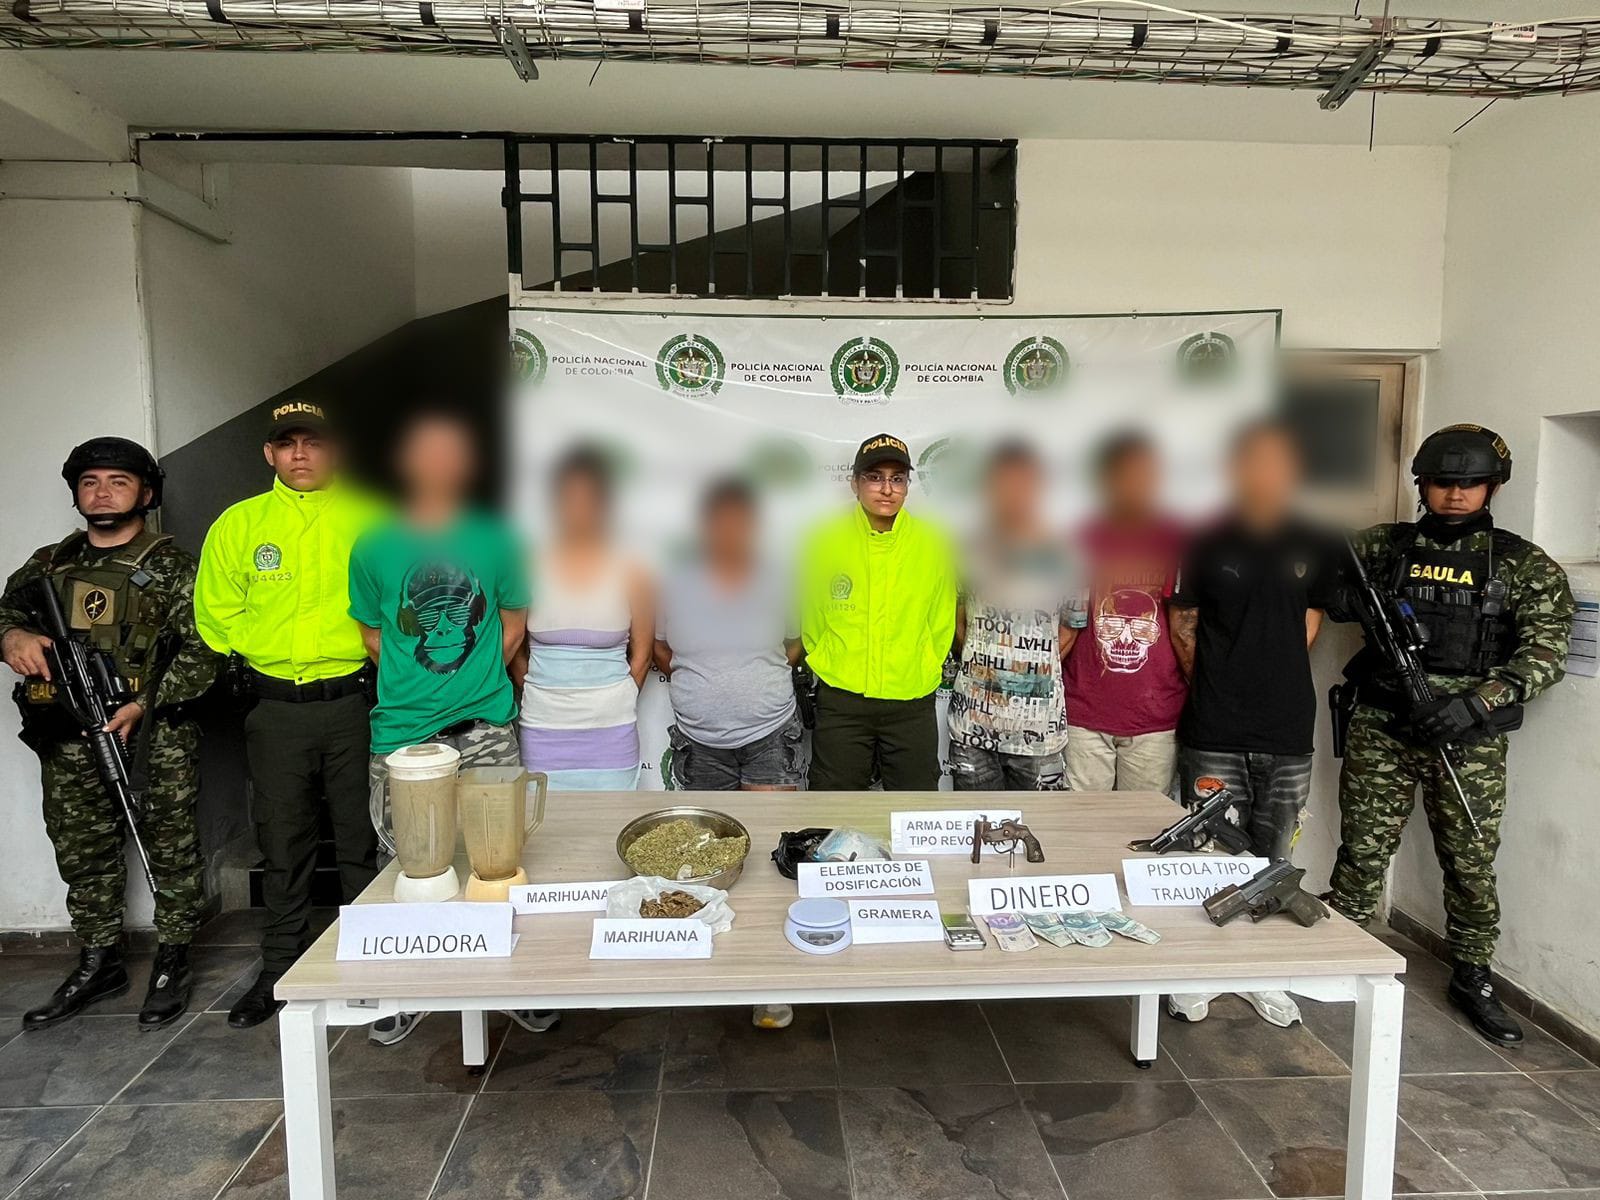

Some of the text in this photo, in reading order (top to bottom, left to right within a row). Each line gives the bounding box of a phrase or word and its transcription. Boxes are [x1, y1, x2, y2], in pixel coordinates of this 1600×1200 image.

[552, 354, 648, 368] POLICÍA NACIONAL
[731, 362, 825, 372] POLICÍA NACIONAL
[905, 362, 998, 372] POLICÍA NACIONAL
[565, 367, 578, 376] DE
[744, 374, 812, 383] DE COLOMBIA
[917, 374, 984, 383] DE COLOMBIA
[1410, 564, 1474, 586] GAULA
[906, 820, 942, 831] ARMA
[945, 820, 962, 831] DE
[909, 835, 937, 846] TIPO
[819, 862, 923, 877] ELEMENTOS DE
[1146, 862, 1250, 877] PISTOLA TIPO
[825, 876, 922, 891] DOSIFICACIÓN
[526, 888, 608, 904] MARIHUANA
[990, 883, 1090, 910] DINERO
[857, 908, 934, 920] GRAMERA
[603, 929, 699, 944] MARIHUANA
[361, 933, 488, 955] LICUADORA
